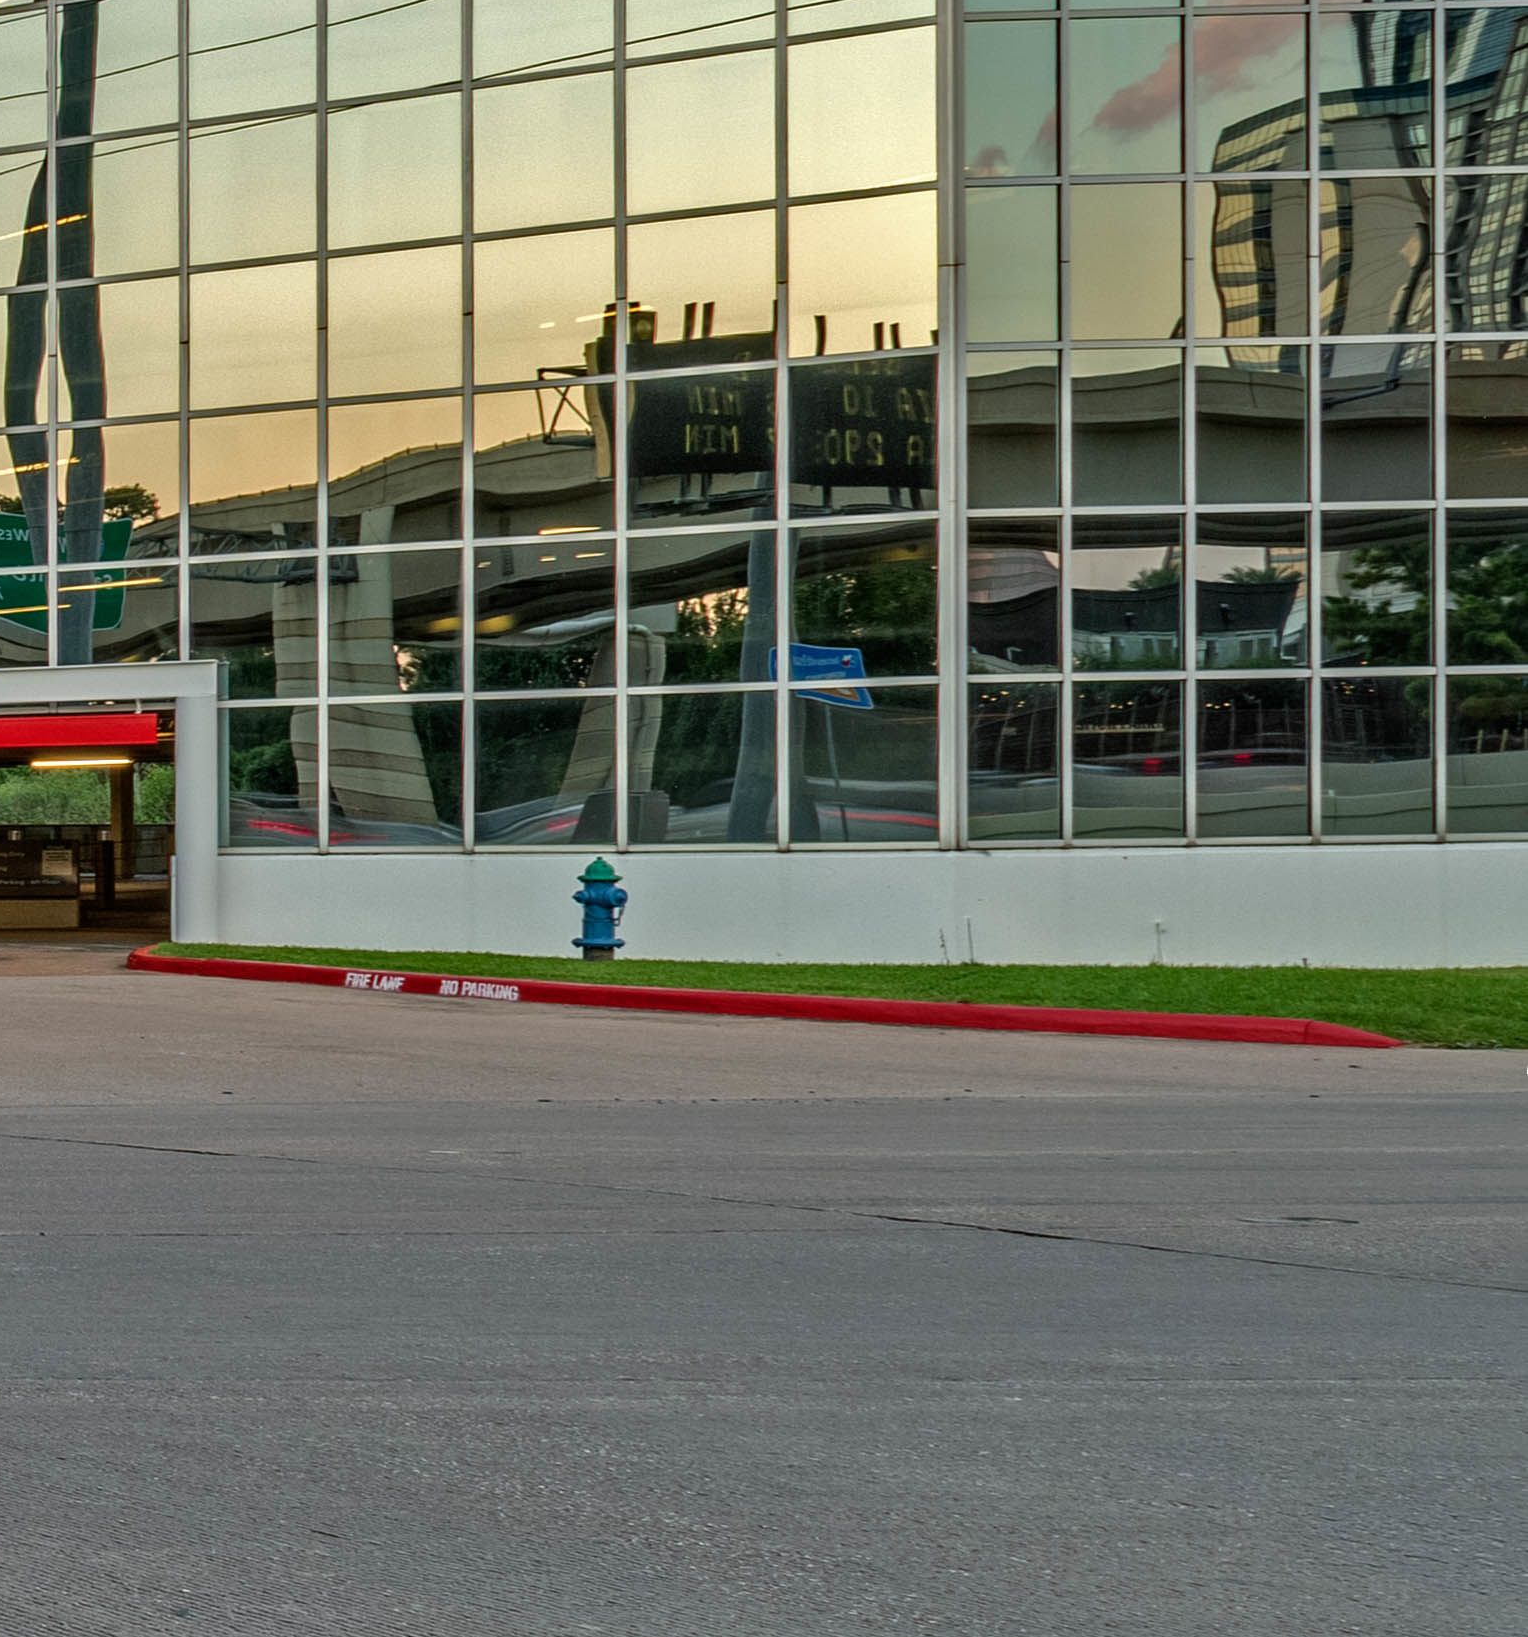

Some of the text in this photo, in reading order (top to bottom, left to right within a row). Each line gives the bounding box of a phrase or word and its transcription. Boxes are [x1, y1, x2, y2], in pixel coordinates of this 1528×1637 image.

[345, 972, 520, 1001] FIRE LANE NO PARKING
